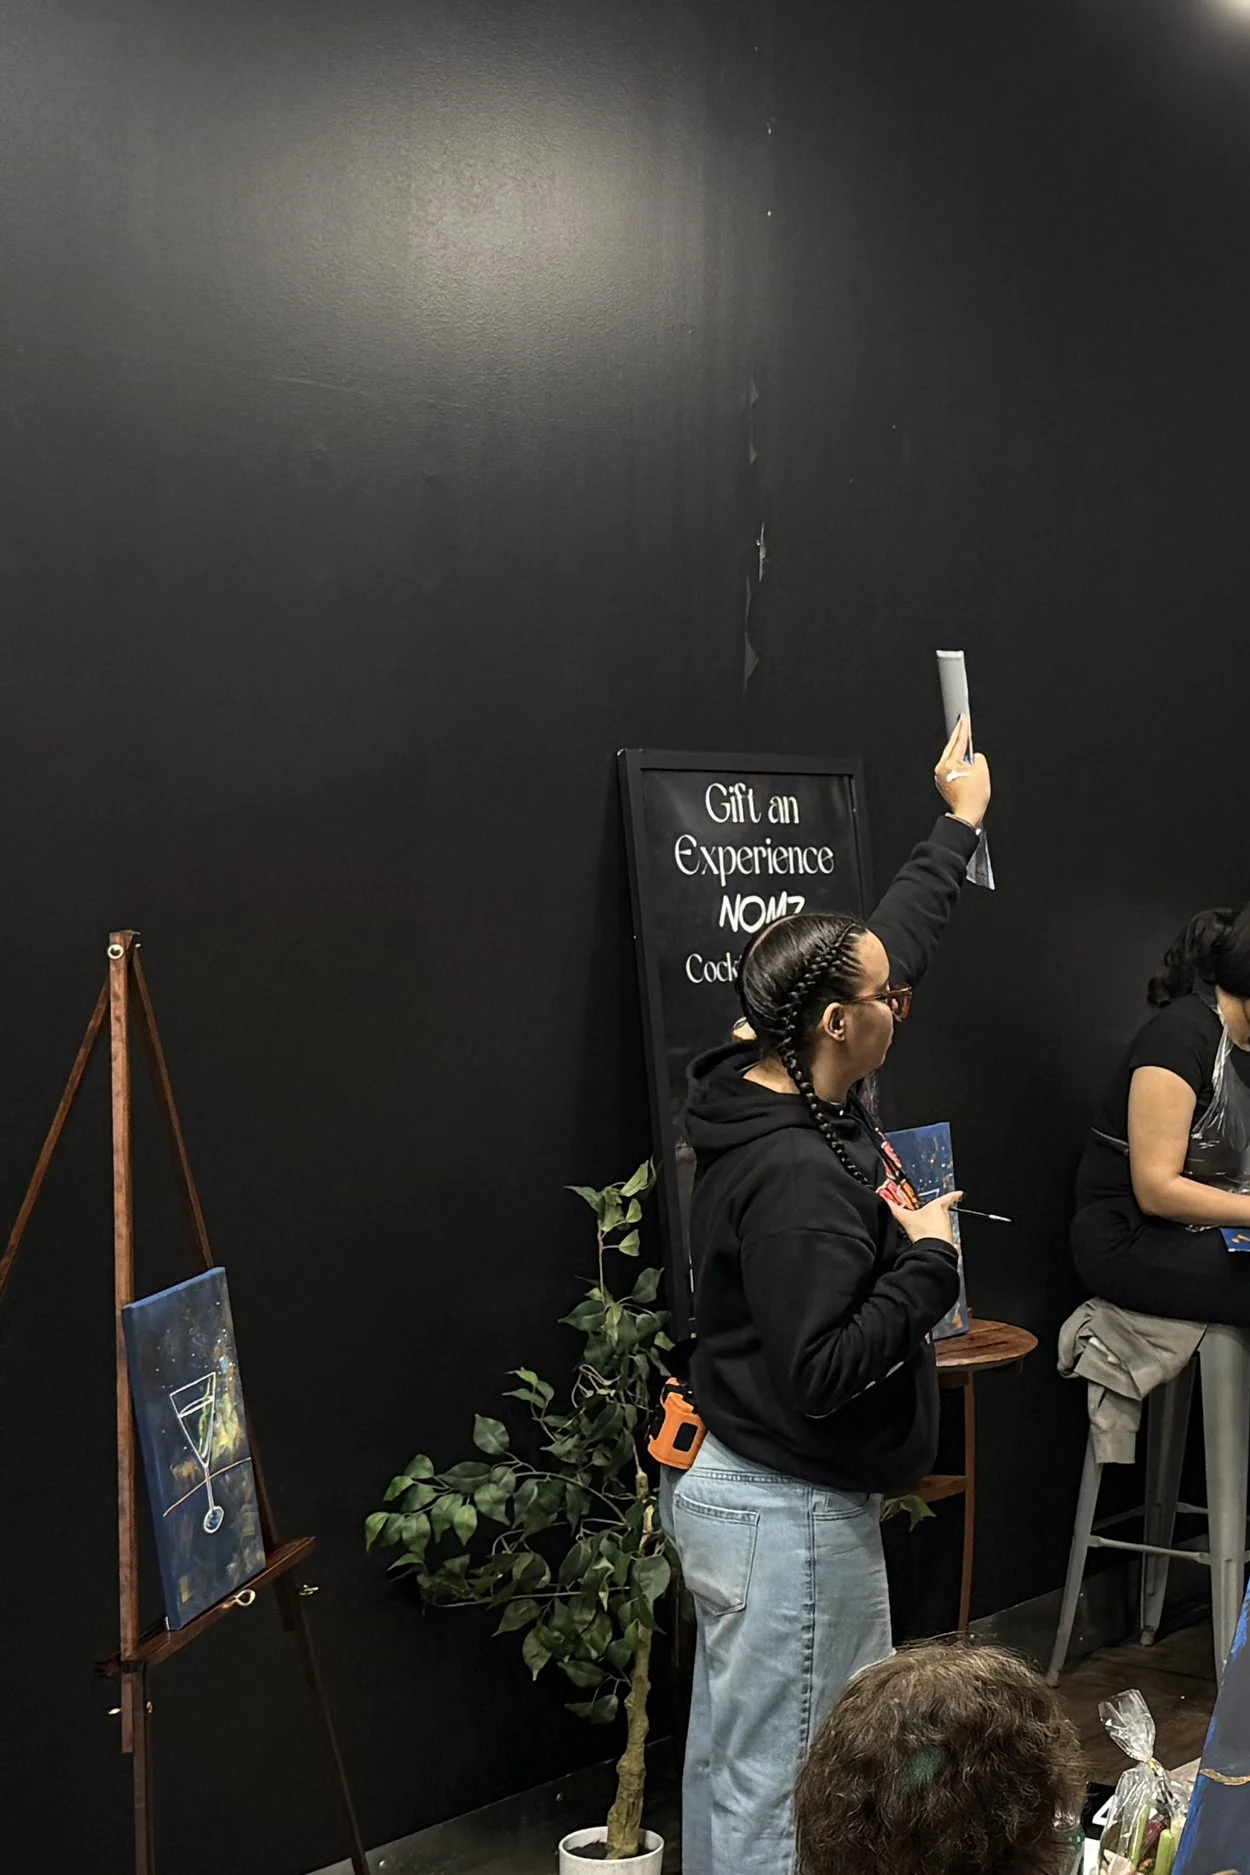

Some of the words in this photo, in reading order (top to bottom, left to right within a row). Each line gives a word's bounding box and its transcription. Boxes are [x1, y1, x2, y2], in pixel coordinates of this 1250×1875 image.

[705, 782, 762, 823] Gift
[767, 796, 800, 824] an
[674, 834, 834, 887] Experience
[685, 952, 742, 984] Cock
